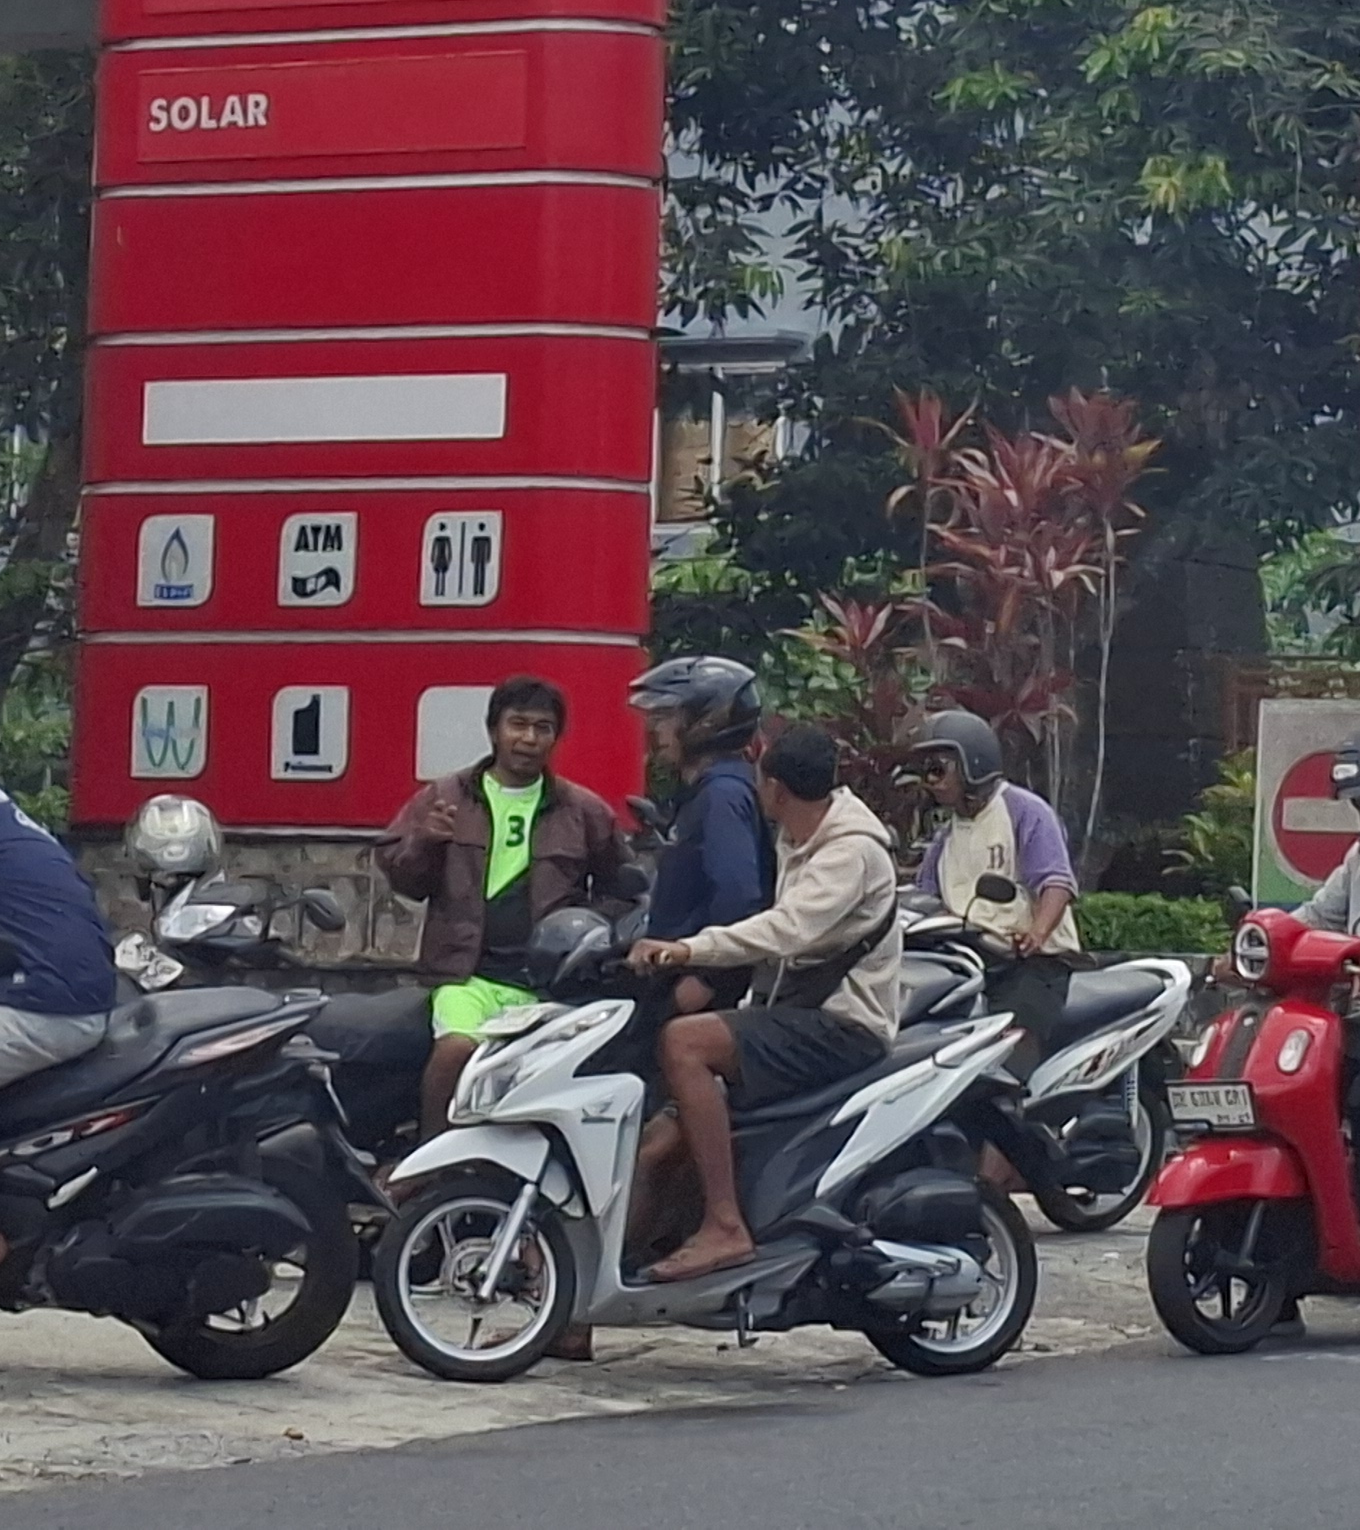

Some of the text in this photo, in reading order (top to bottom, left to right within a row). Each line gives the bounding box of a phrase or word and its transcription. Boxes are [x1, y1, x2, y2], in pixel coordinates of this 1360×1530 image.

[148, 93, 269, 132] SOLAR
[294, 524, 343, 553] ATM
[506, 815, 526, 848] 3
